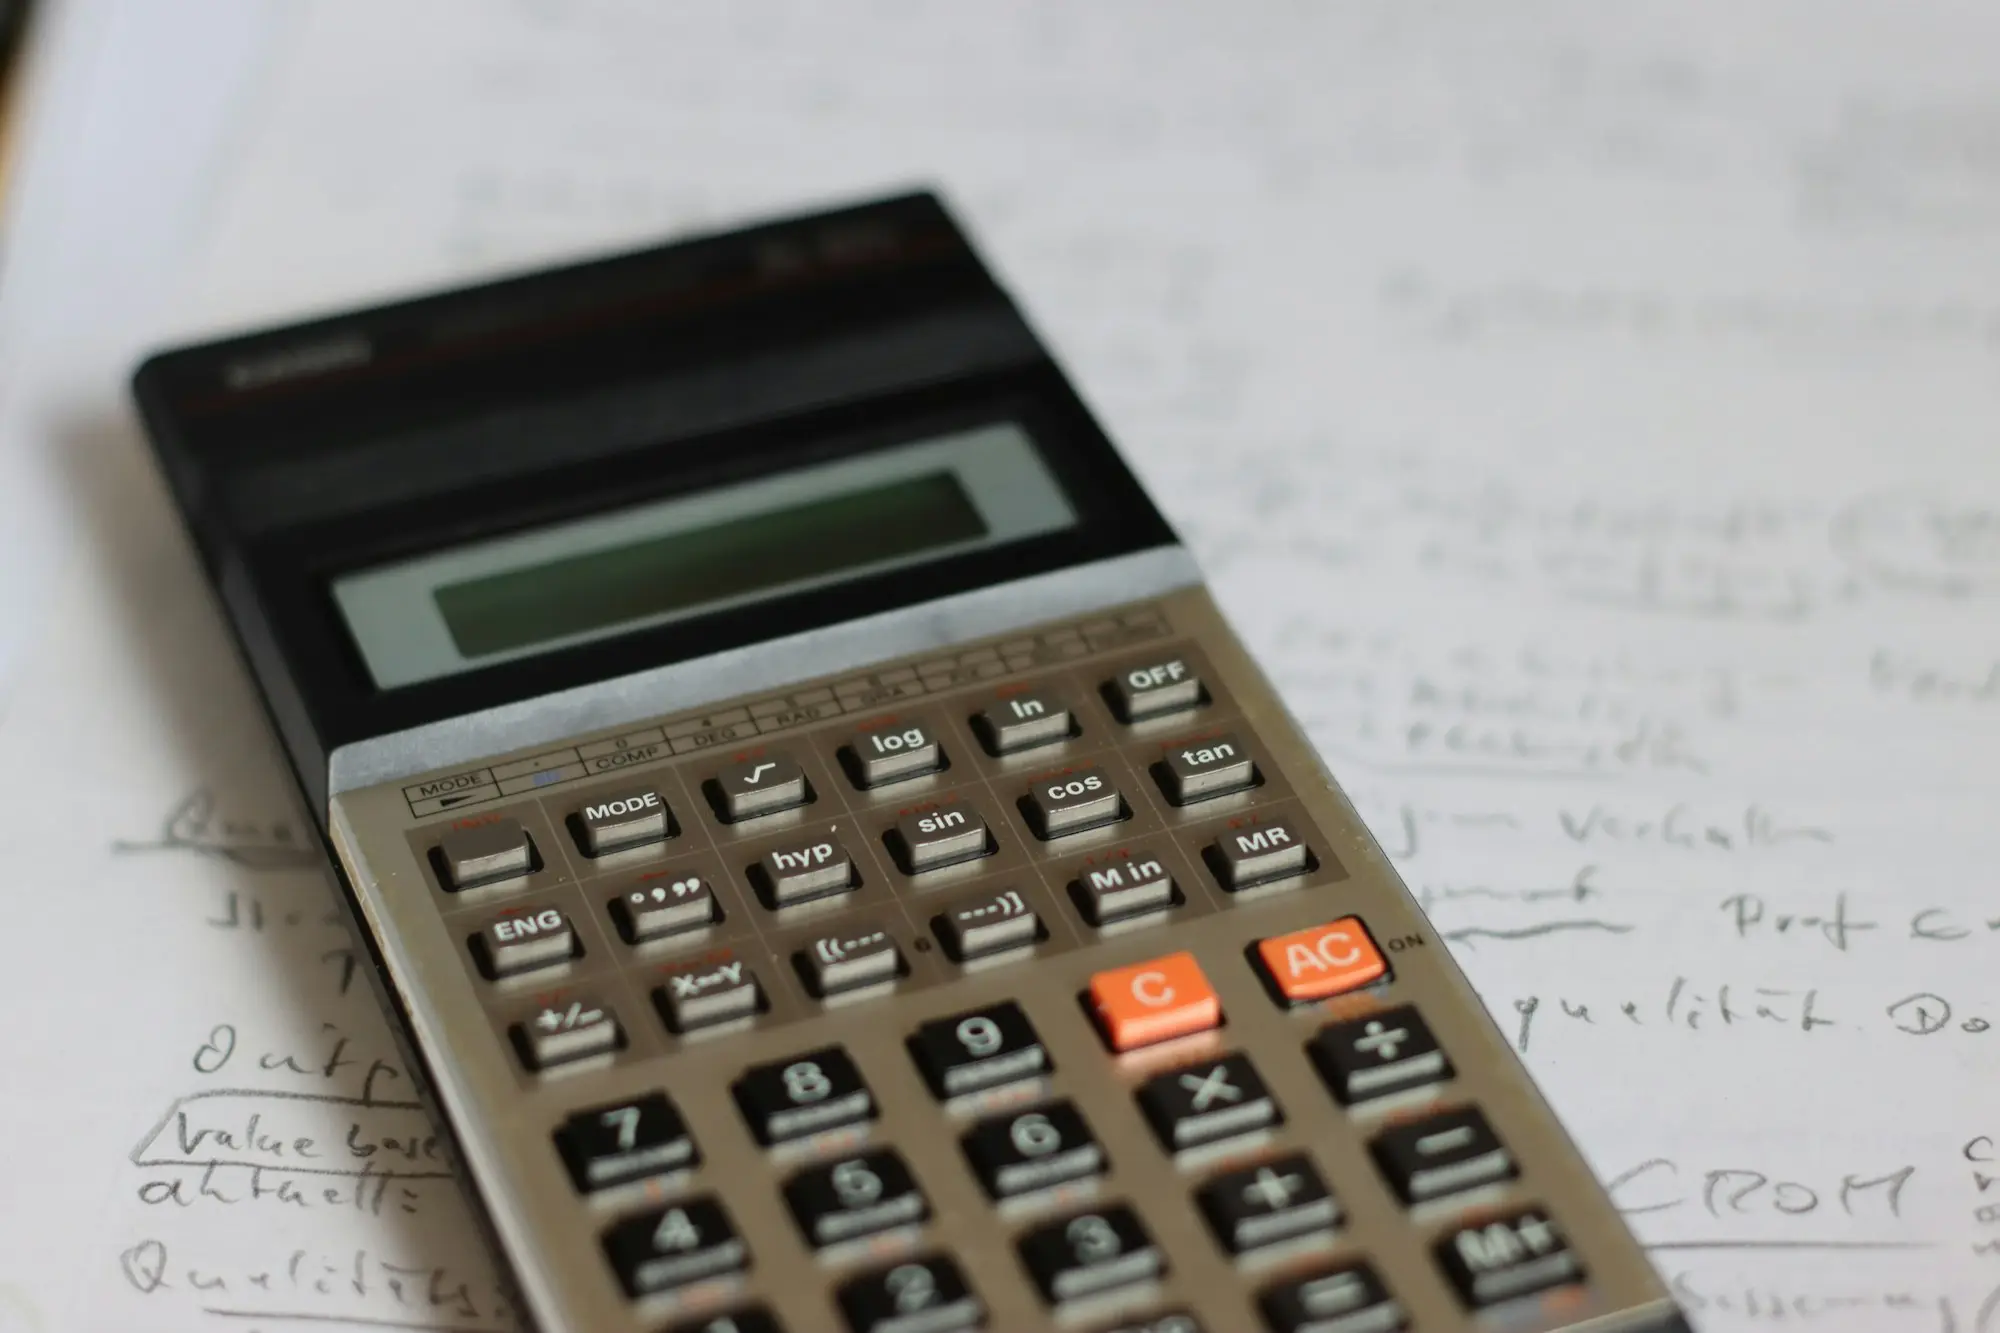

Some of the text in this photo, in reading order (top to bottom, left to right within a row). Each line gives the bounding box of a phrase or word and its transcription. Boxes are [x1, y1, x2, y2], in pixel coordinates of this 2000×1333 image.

[1128, 660, 1186, 689] OFF
[871, 727, 925, 753] log
[1181, 740, 1235, 767] tan
[595, 747, 659, 770] COMP
[420, 774, 482, 797] MODE
[1048, 774, 1103, 800] cos
[585, 792, 660, 821] MODE
[918, 809, 966, 834] sin
[771, 838, 834, 870] hyp
[1235, 826, 1292, 854] MR
[492, 909, 563, 942] ENG
[1285, 931, 1361, 978] AC
[1388, 933, 1426, 953] ON
[1130, 971, 1177, 1008] C
[956, 1015, 1003, 1058] 9
[782, 1060, 832, 1102] 8
[602, 1105, 641, 1150] 7
[1010, 1113, 1061, 1158] 6
[831, 1159, 884, 1210] 5
[652, 1207, 701, 1250] 4
[1065, 1213, 1122, 1265] 3
[885, 1263, 938, 1310] 2
